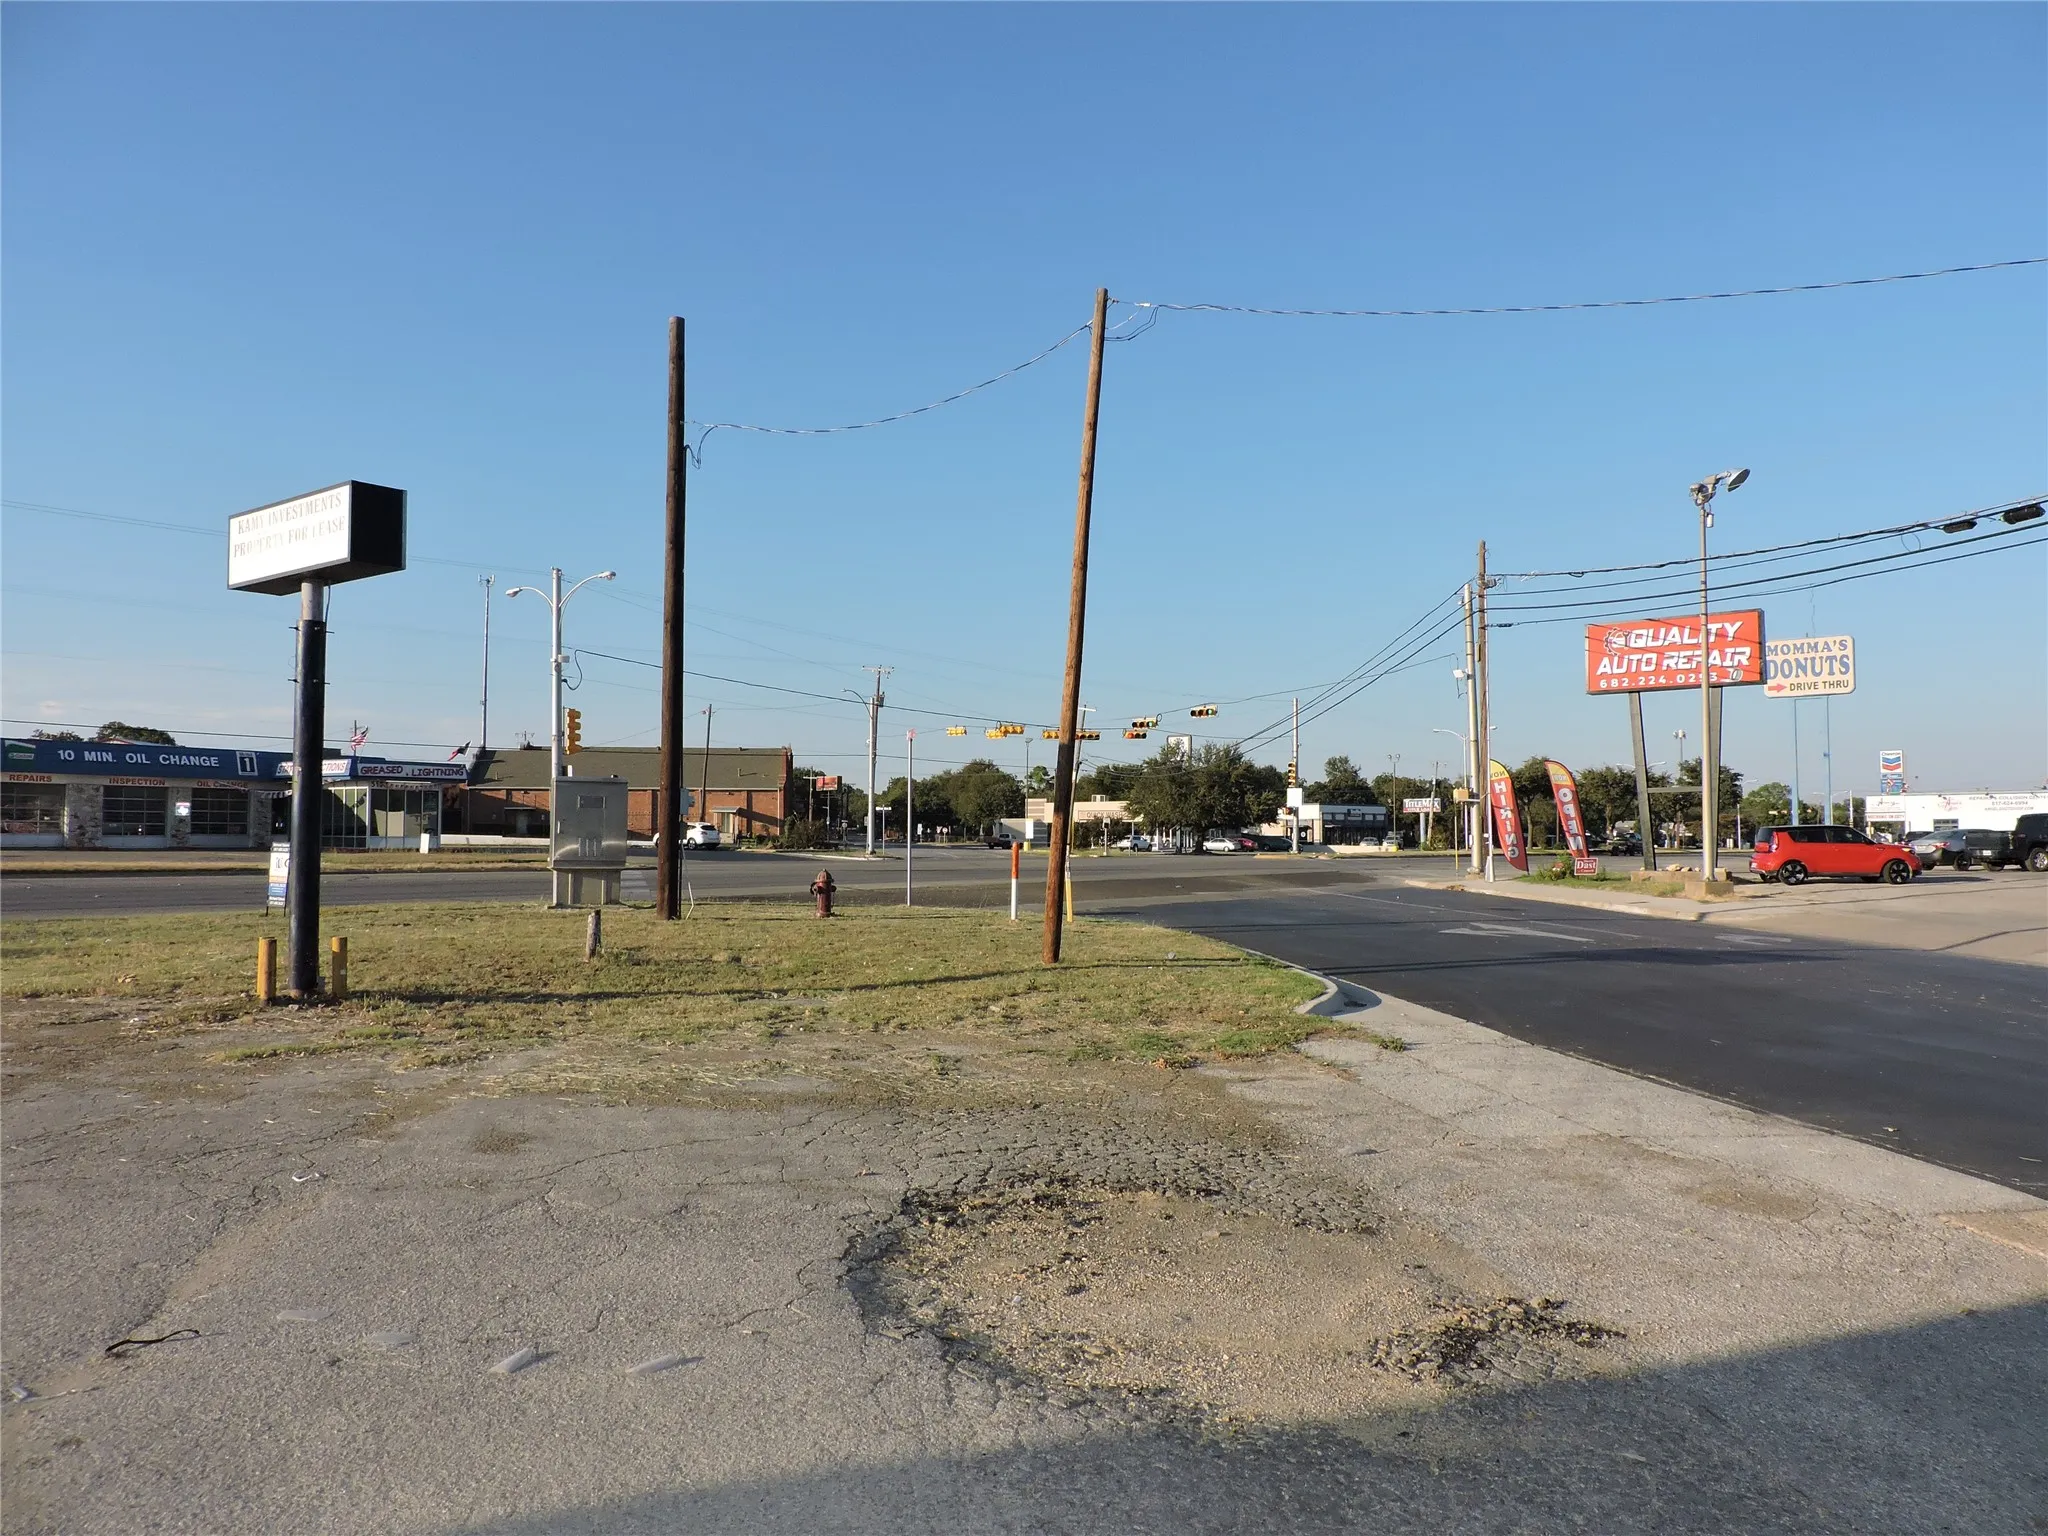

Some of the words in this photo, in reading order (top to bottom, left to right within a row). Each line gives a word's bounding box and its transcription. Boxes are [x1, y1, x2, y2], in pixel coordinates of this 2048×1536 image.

[268, 491, 342, 526] INVESTMENTS
[288, 526, 308, 544] FOR
[312, 516, 346, 538] LEASE
[1767, 639, 1848, 656] MOMMA'S
[1597, 653, 1658, 676] AUTO
[1662, 648, 1751, 671] REPAIR
[1767, 654, 1850, 680] DONUTS
[1789, 681, 1819, 691] DRIVE
[1822, 680, 1849, 689] THRU
[57, 750, 75, 760] 10
[84, 751, 117, 762] MIN.
[125, 753, 151, 764] OIL
[159, 754, 219, 767] CHANGE
[9, 774, 53, 783] REPAIRS
[360, 765, 403, 776] GREASED
[411, 768, 464, 777] LIGHTNING
[109, 777, 166, 786] INSPECTION
[196, 780, 211, 788] OIL
